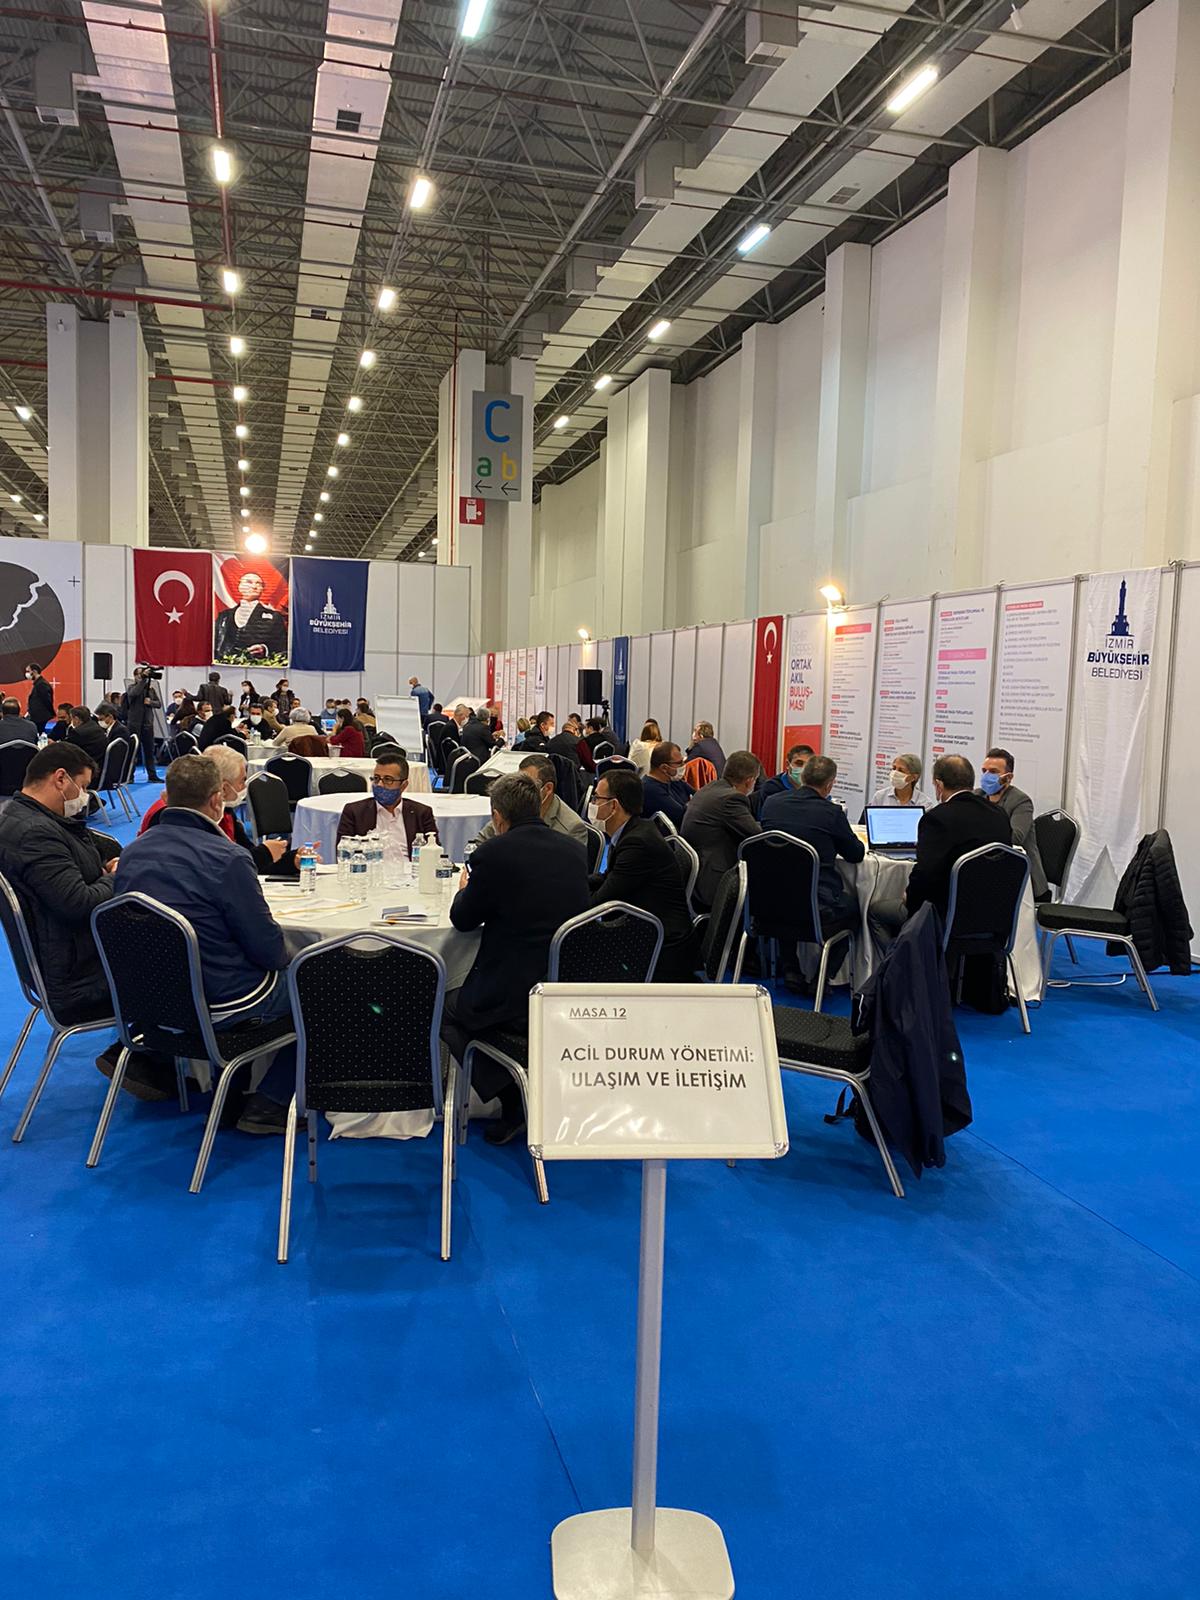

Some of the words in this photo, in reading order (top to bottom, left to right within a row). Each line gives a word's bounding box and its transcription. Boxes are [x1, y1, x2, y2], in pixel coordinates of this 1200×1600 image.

[484, 400, 511, 443] C
[476, 457, 492, 477] a
[502, 451, 517, 481] b
[791, 658, 812, 670] ORTAK
[569, 1007, 607, 1018] MASA
[613, 1007, 626, 1018] 12
[561, 1044, 600, 1061] ACİL
[605, 1047, 665, 1061] DURUM
[670, 1045, 754, 1062] YÖNETİMİ:
[572, 1071, 641, 1090] ULAŞIM
[646, 1071, 670, 1087] VE
[676, 1068, 746, 1091] İLETİŞİM
